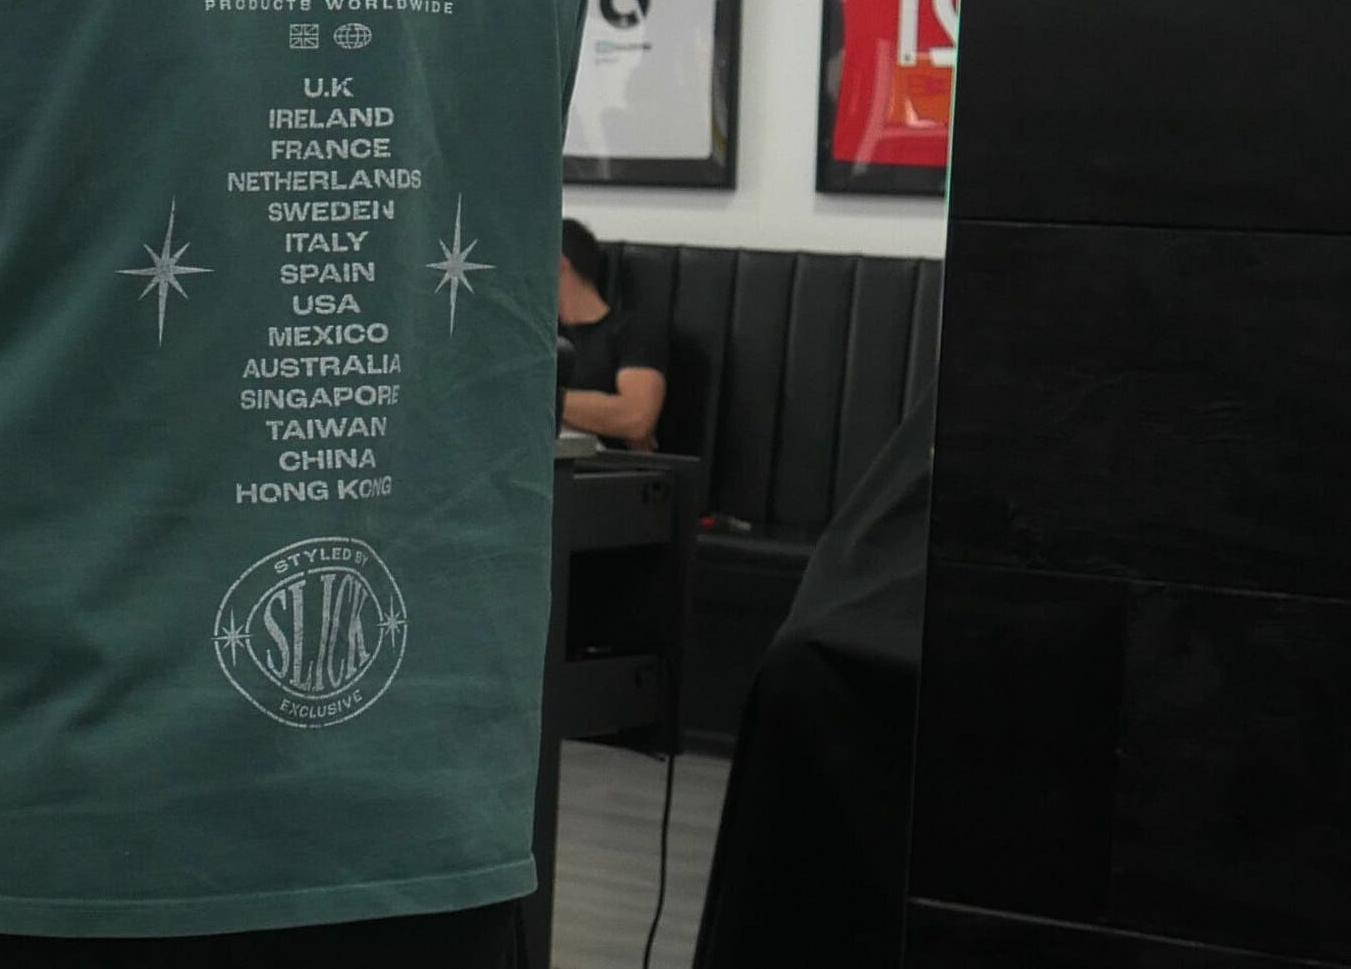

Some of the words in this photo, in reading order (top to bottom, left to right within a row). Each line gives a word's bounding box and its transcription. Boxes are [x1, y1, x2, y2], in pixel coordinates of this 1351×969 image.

[303, 76, 354, 99] U.K
[268, 106, 395, 130] IRELAND
[271, 137, 392, 161] FRANCE
[227, 168, 422, 192] NETHERLANDS
[267, 199, 395, 223] SWEDEN
[285, 230, 369, 253] ITALY
[279, 261, 376, 285] SPAIN
[292, 293, 361, 316] USA
[268, 322, 389, 348] MEXICO
[241, 353, 402, 379] AUSTRALIA
[240, 384, 401, 410] SINGAPORE
[265, 416, 388, 441] TAIWAN
[278, 447, 377, 472] CHINA
[235, 479, 330, 504] HONG
[337, 475, 393, 500] KONG
[274, 547, 352, 574] STYLED
[354, 550, 368, 566] BY
[263, 573, 370, 691] SLICK
[280, 689, 363, 718] EXCLUSIVE
